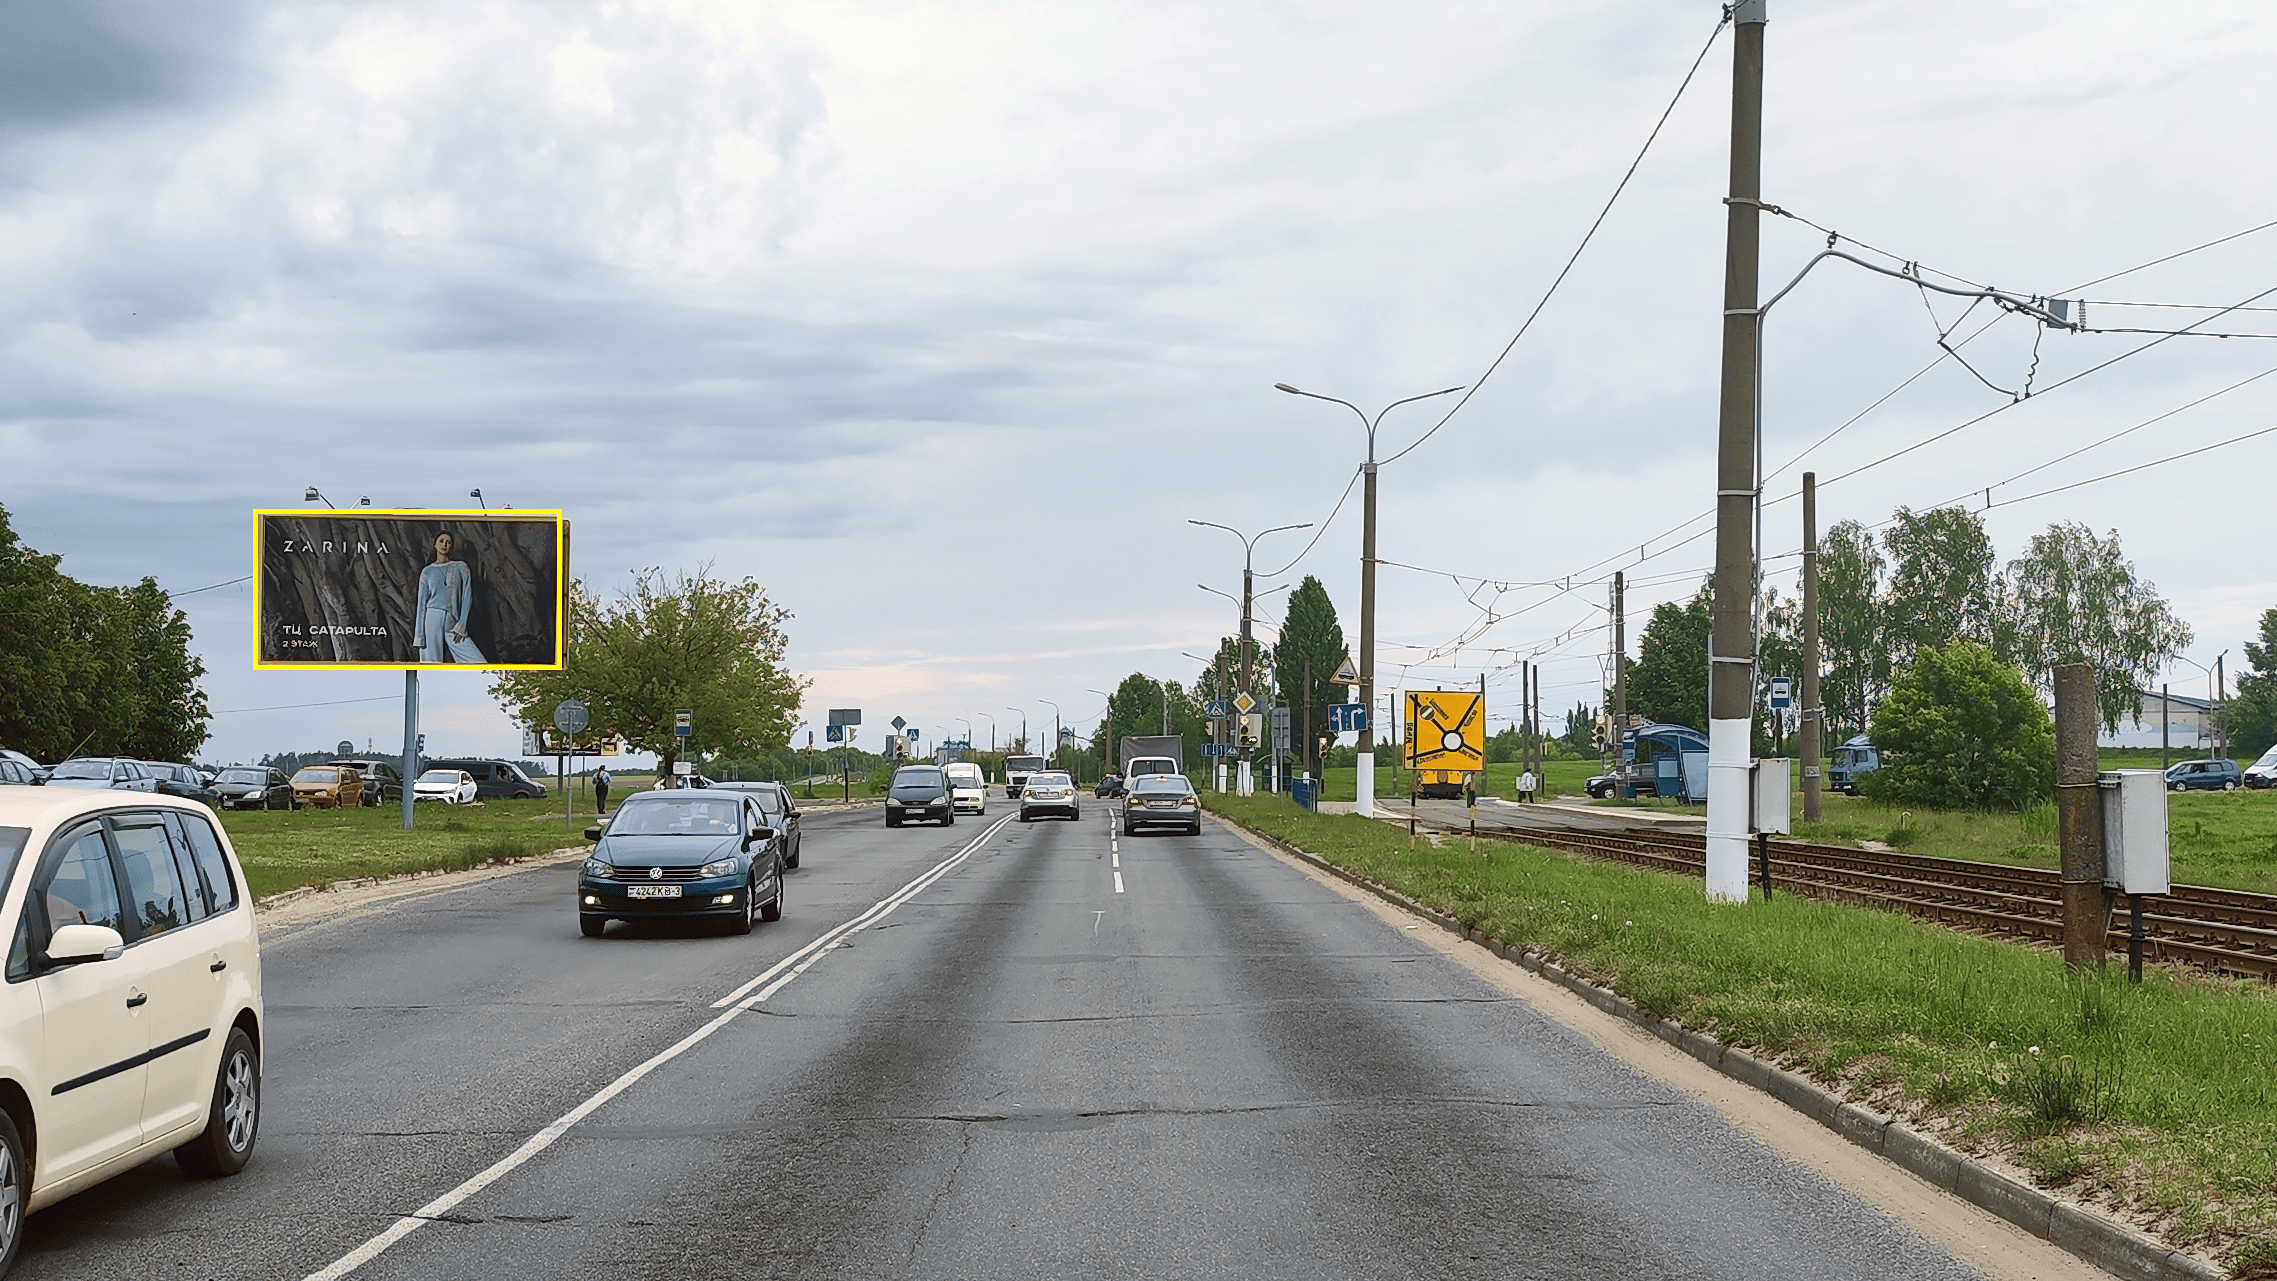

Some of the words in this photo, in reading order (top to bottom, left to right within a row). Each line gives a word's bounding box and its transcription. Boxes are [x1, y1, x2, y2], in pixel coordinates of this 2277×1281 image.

[283, 540, 391, 554] ZARINA
[282, 624, 302, 636] ТЦ
[309, 625, 388, 637] CATAPULTA
[282, 640, 289, 648] 2
